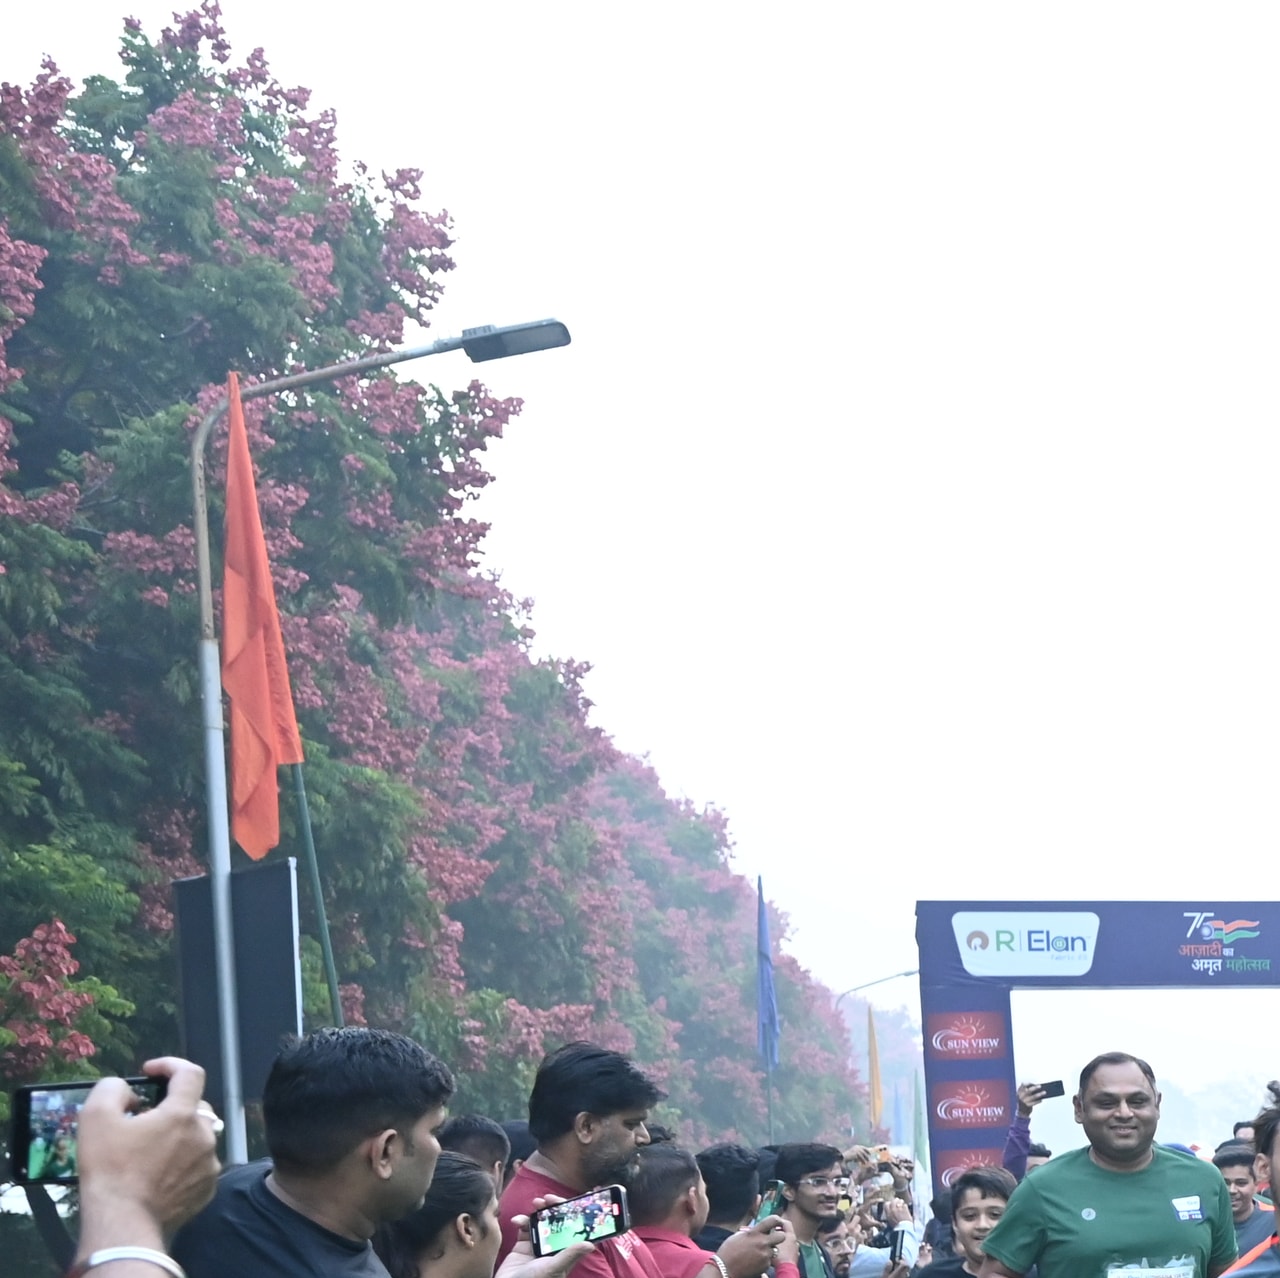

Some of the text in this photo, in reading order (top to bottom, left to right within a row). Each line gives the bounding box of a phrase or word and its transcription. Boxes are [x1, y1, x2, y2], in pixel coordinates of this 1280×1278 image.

[1027, 930, 1087, 952] Elan
[1223, 948, 1234, 957] का
[1191, 955, 1272, 976] अमृत महोत्सव
[947, 1038, 999, 1049] SUN VIEW
[952, 1106, 1004, 1118] SUN VIEW
